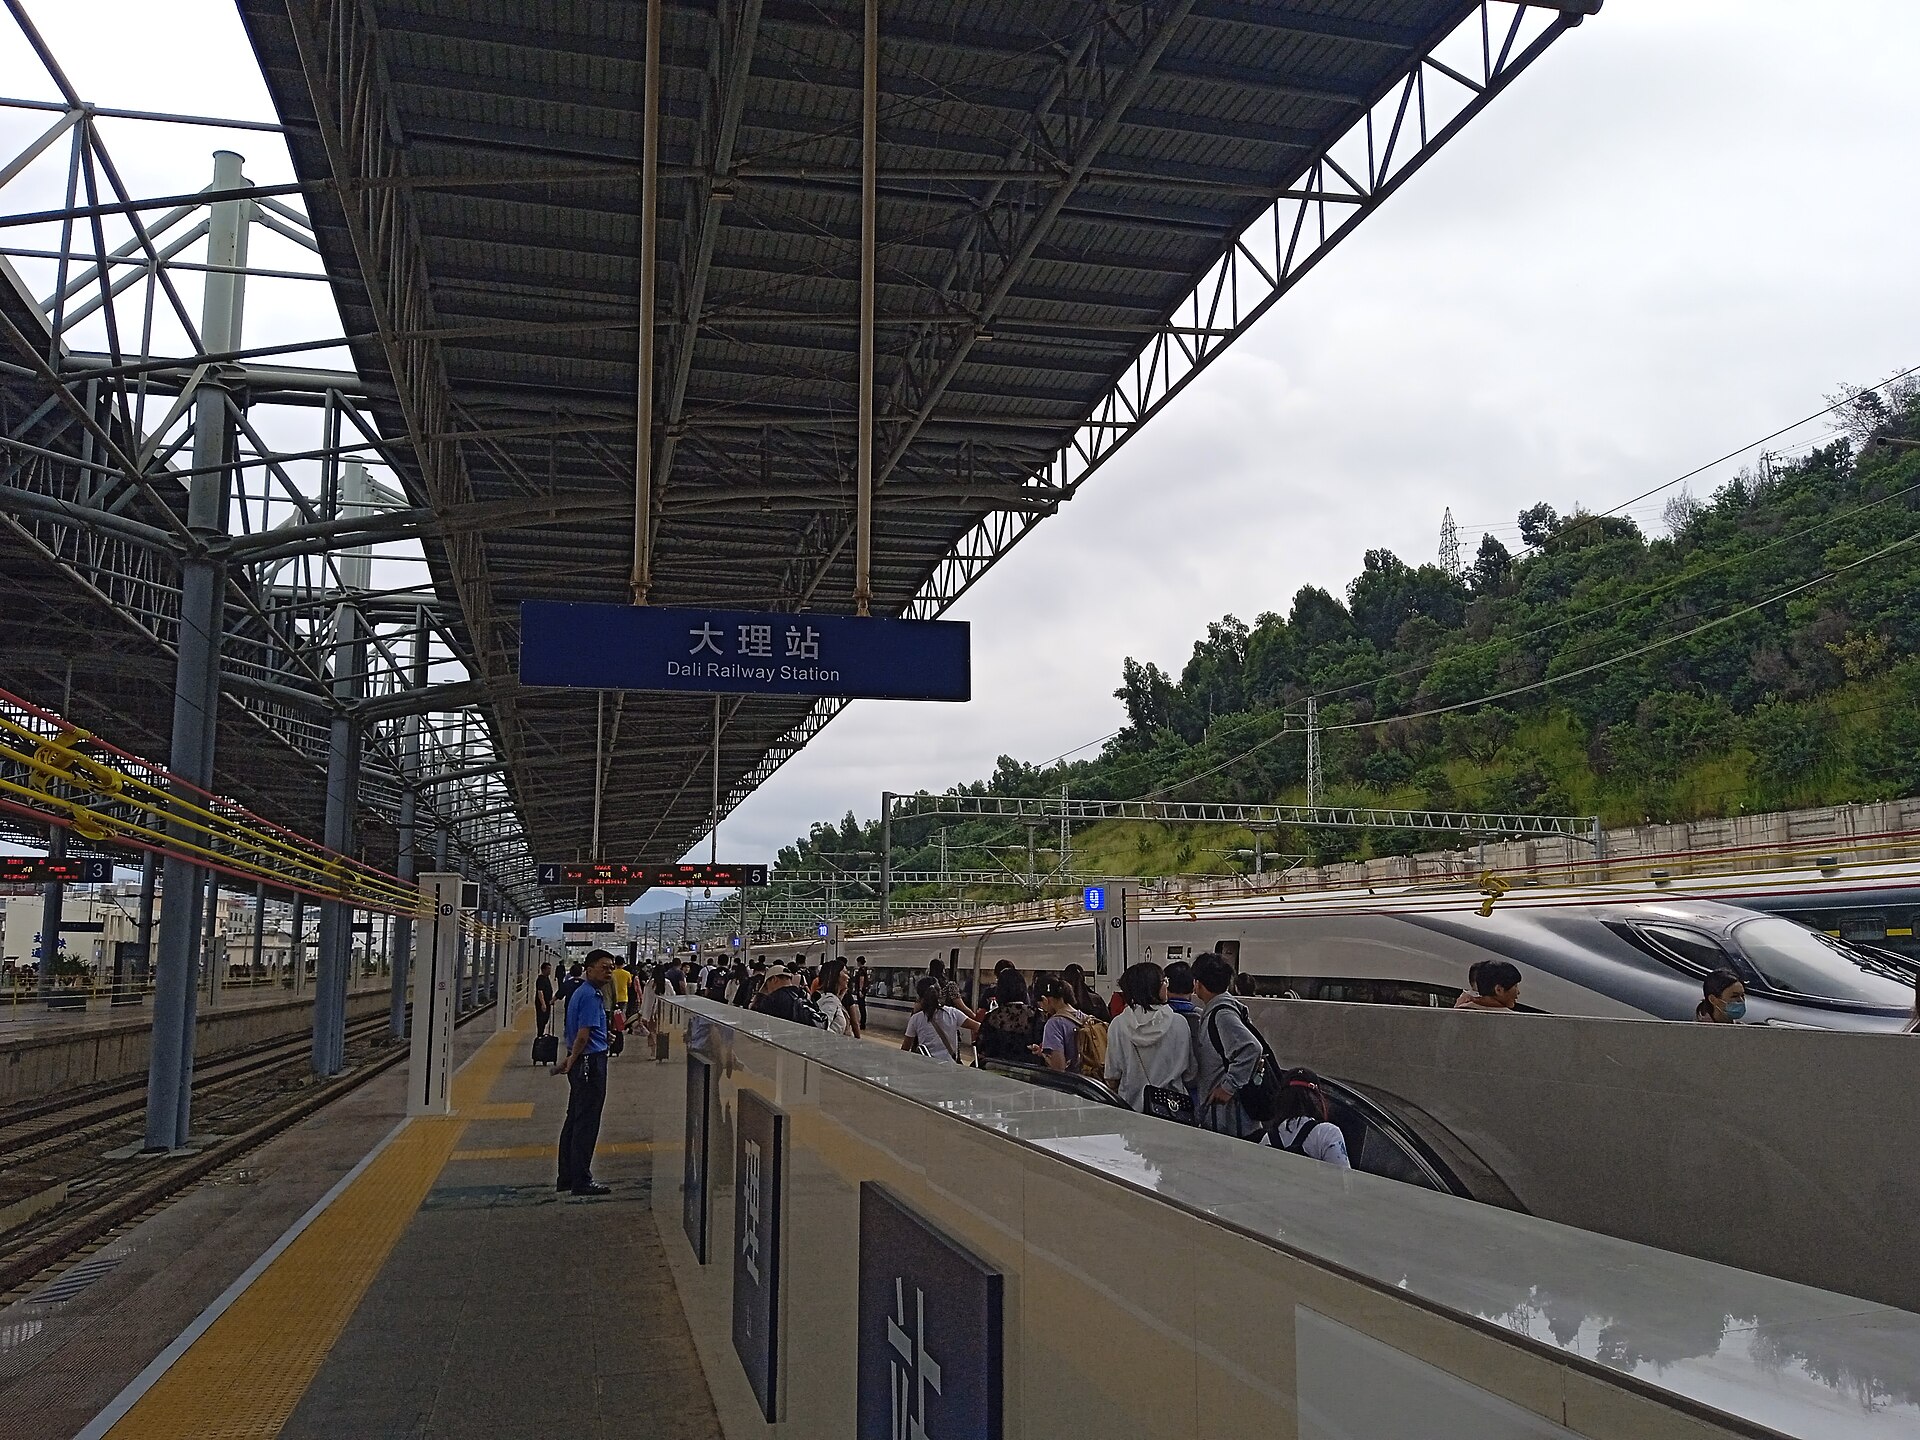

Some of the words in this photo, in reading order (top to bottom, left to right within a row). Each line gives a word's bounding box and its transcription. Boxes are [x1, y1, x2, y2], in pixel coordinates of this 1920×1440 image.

[688, 620, 820, 660] 大理站
[667, 660, 702, 677] Dali
[706, 662, 776, 683] Railway
[780, 665, 840, 682] Station
[92, 863, 103, 878] 3
[544, 867, 555, 882] 4
[751, 869, 761, 883] 5
[1089, 889, 1099, 909] 9
[442, 905, 452, 915] 13
[818, 926, 828, 936] 10
